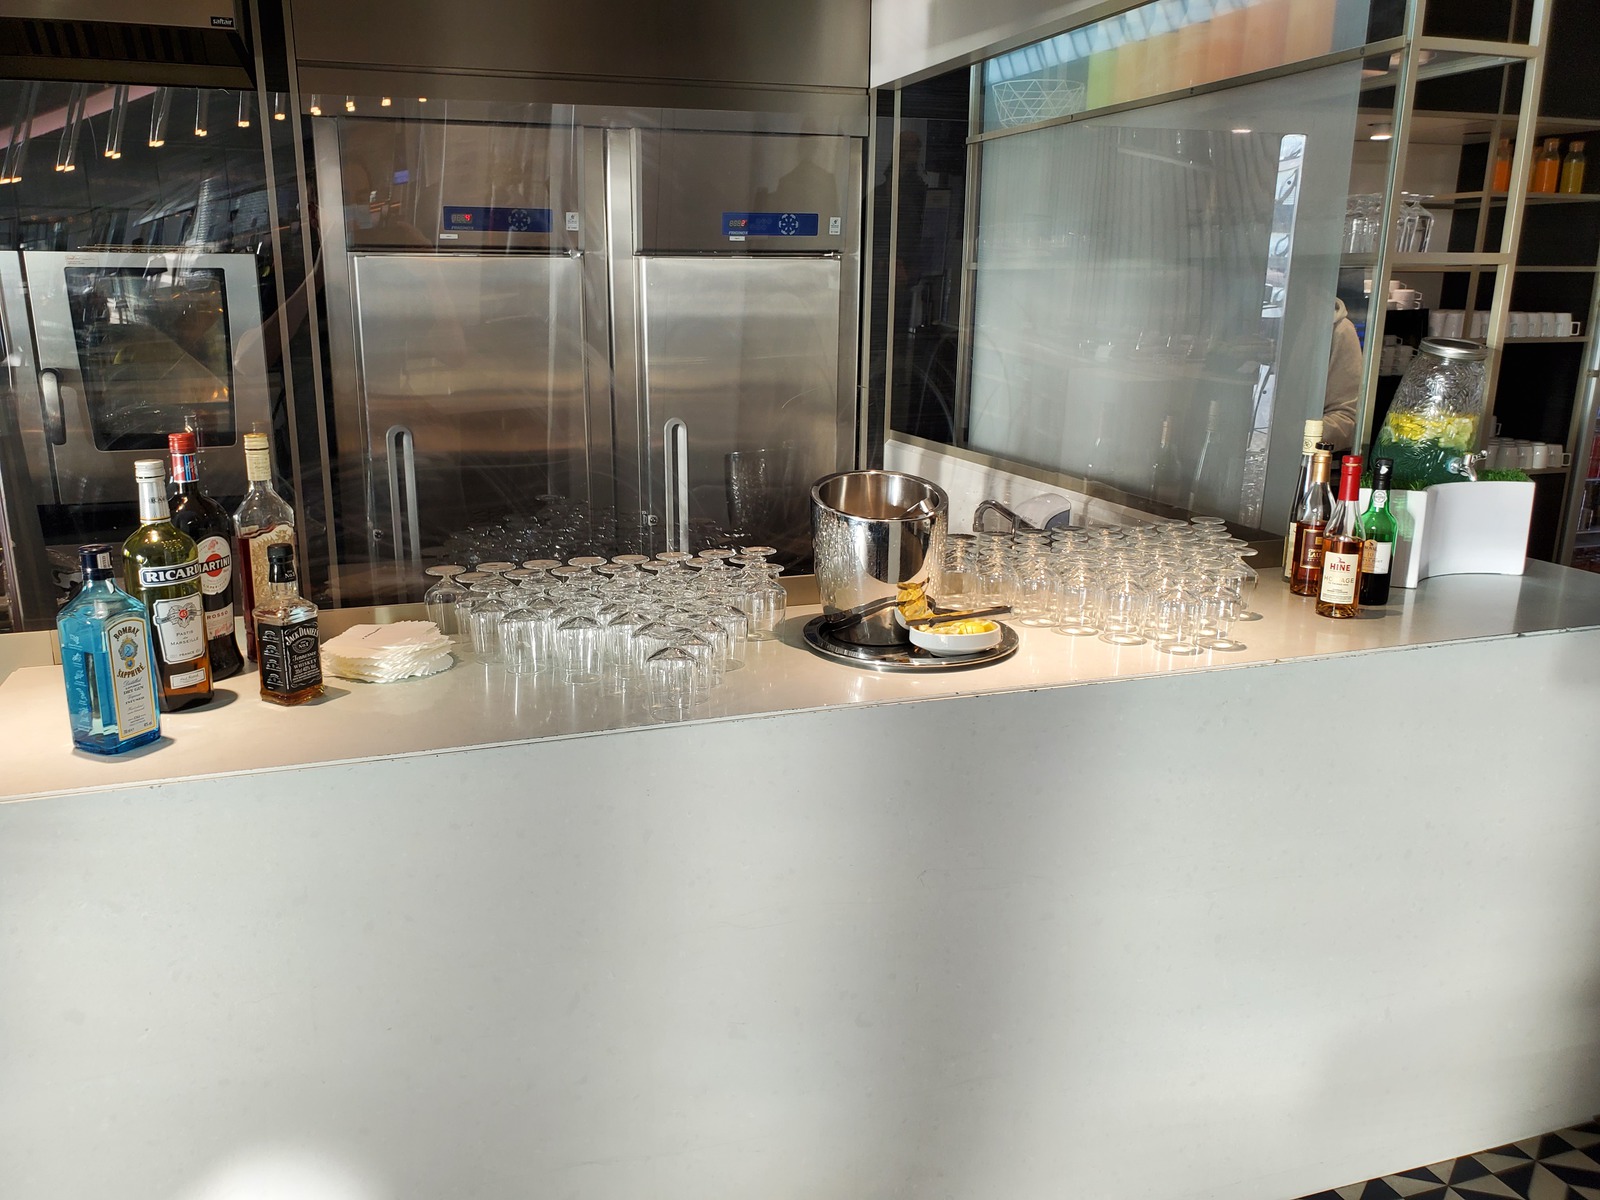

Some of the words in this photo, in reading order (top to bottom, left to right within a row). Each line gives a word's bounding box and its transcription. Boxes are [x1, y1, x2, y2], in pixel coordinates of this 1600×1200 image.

[1329, 562, 1351, 572] HINE
[145, 563, 201, 583] RICARD
[1323, 575, 1355, 584] HOAGE
[206, 610, 229, 620] ROSSO
[113, 625, 140, 641] BOMBAY
[176, 629, 194, 637] PASTIS
[285, 630, 300, 646] JACK
[170, 636, 199, 646] MARSEILLE
[117, 662, 146, 678] SAPPHIRE
